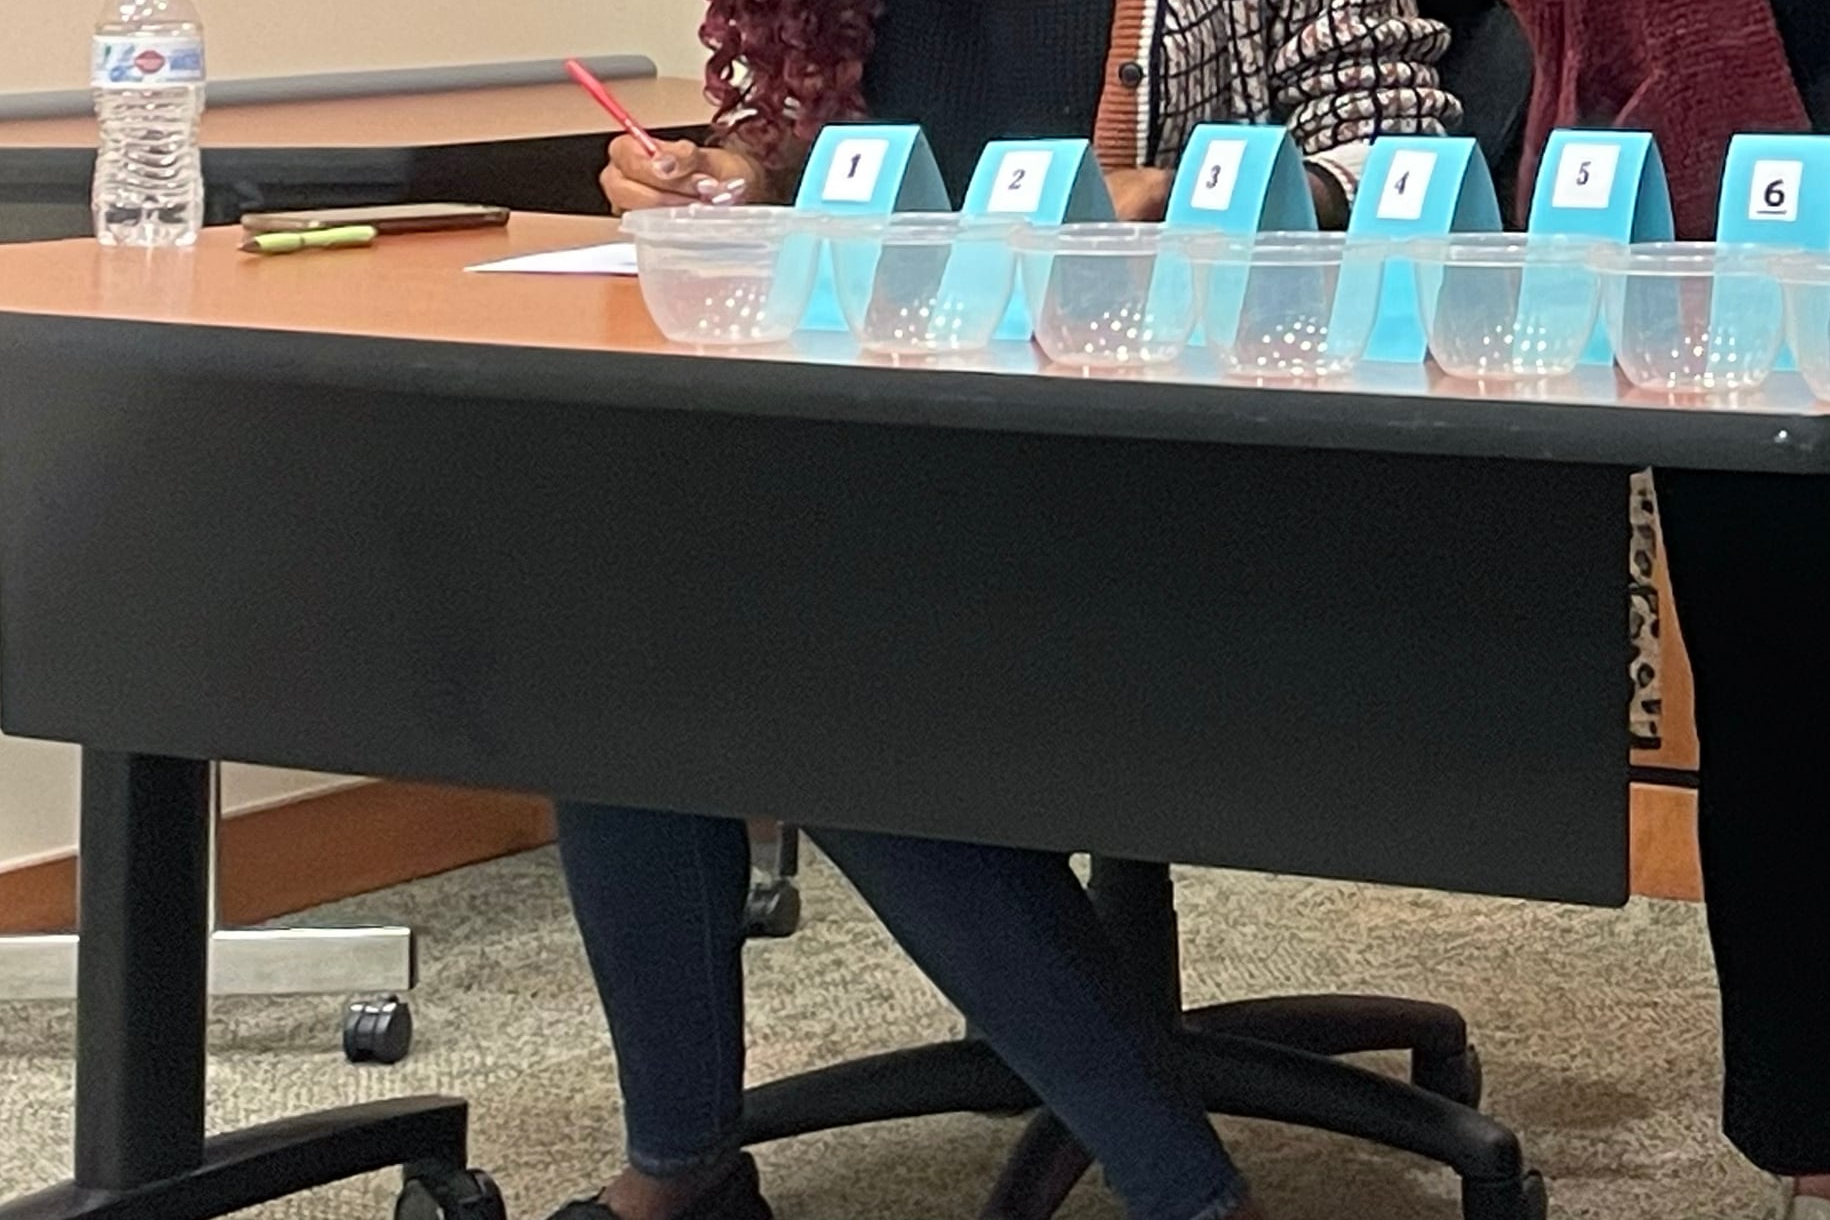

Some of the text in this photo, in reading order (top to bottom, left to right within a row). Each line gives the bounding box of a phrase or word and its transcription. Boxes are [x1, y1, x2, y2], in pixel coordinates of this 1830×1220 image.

[847, 154, 861, 178] 1
[1206, 165, 1221, 188] 3
[1576, 161, 1591, 186] 5
[1008, 170, 1025, 190] 2
[1394, 171, 1409, 195] 4
[1763, 179, 1786, 208] 6
